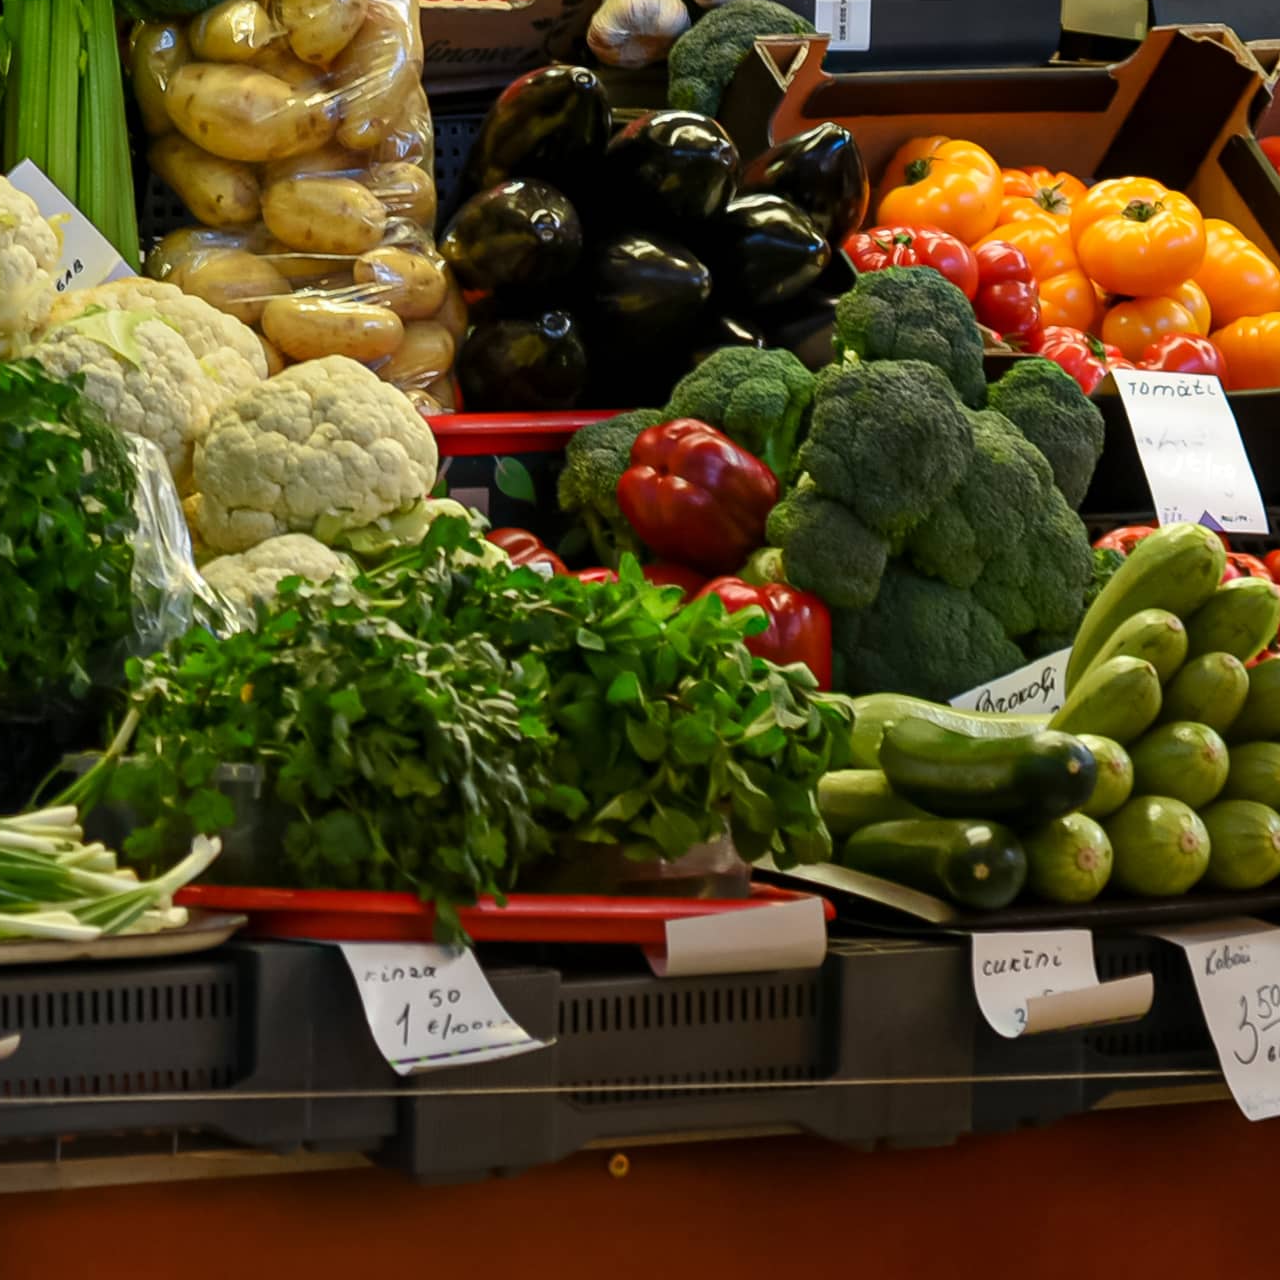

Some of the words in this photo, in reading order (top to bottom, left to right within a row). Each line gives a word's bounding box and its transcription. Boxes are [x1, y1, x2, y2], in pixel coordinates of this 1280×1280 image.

[395, 1002, 411, 1047] 1
[428, 988, 462, 1009] 50
[1233, 995, 1259, 1065] 3
